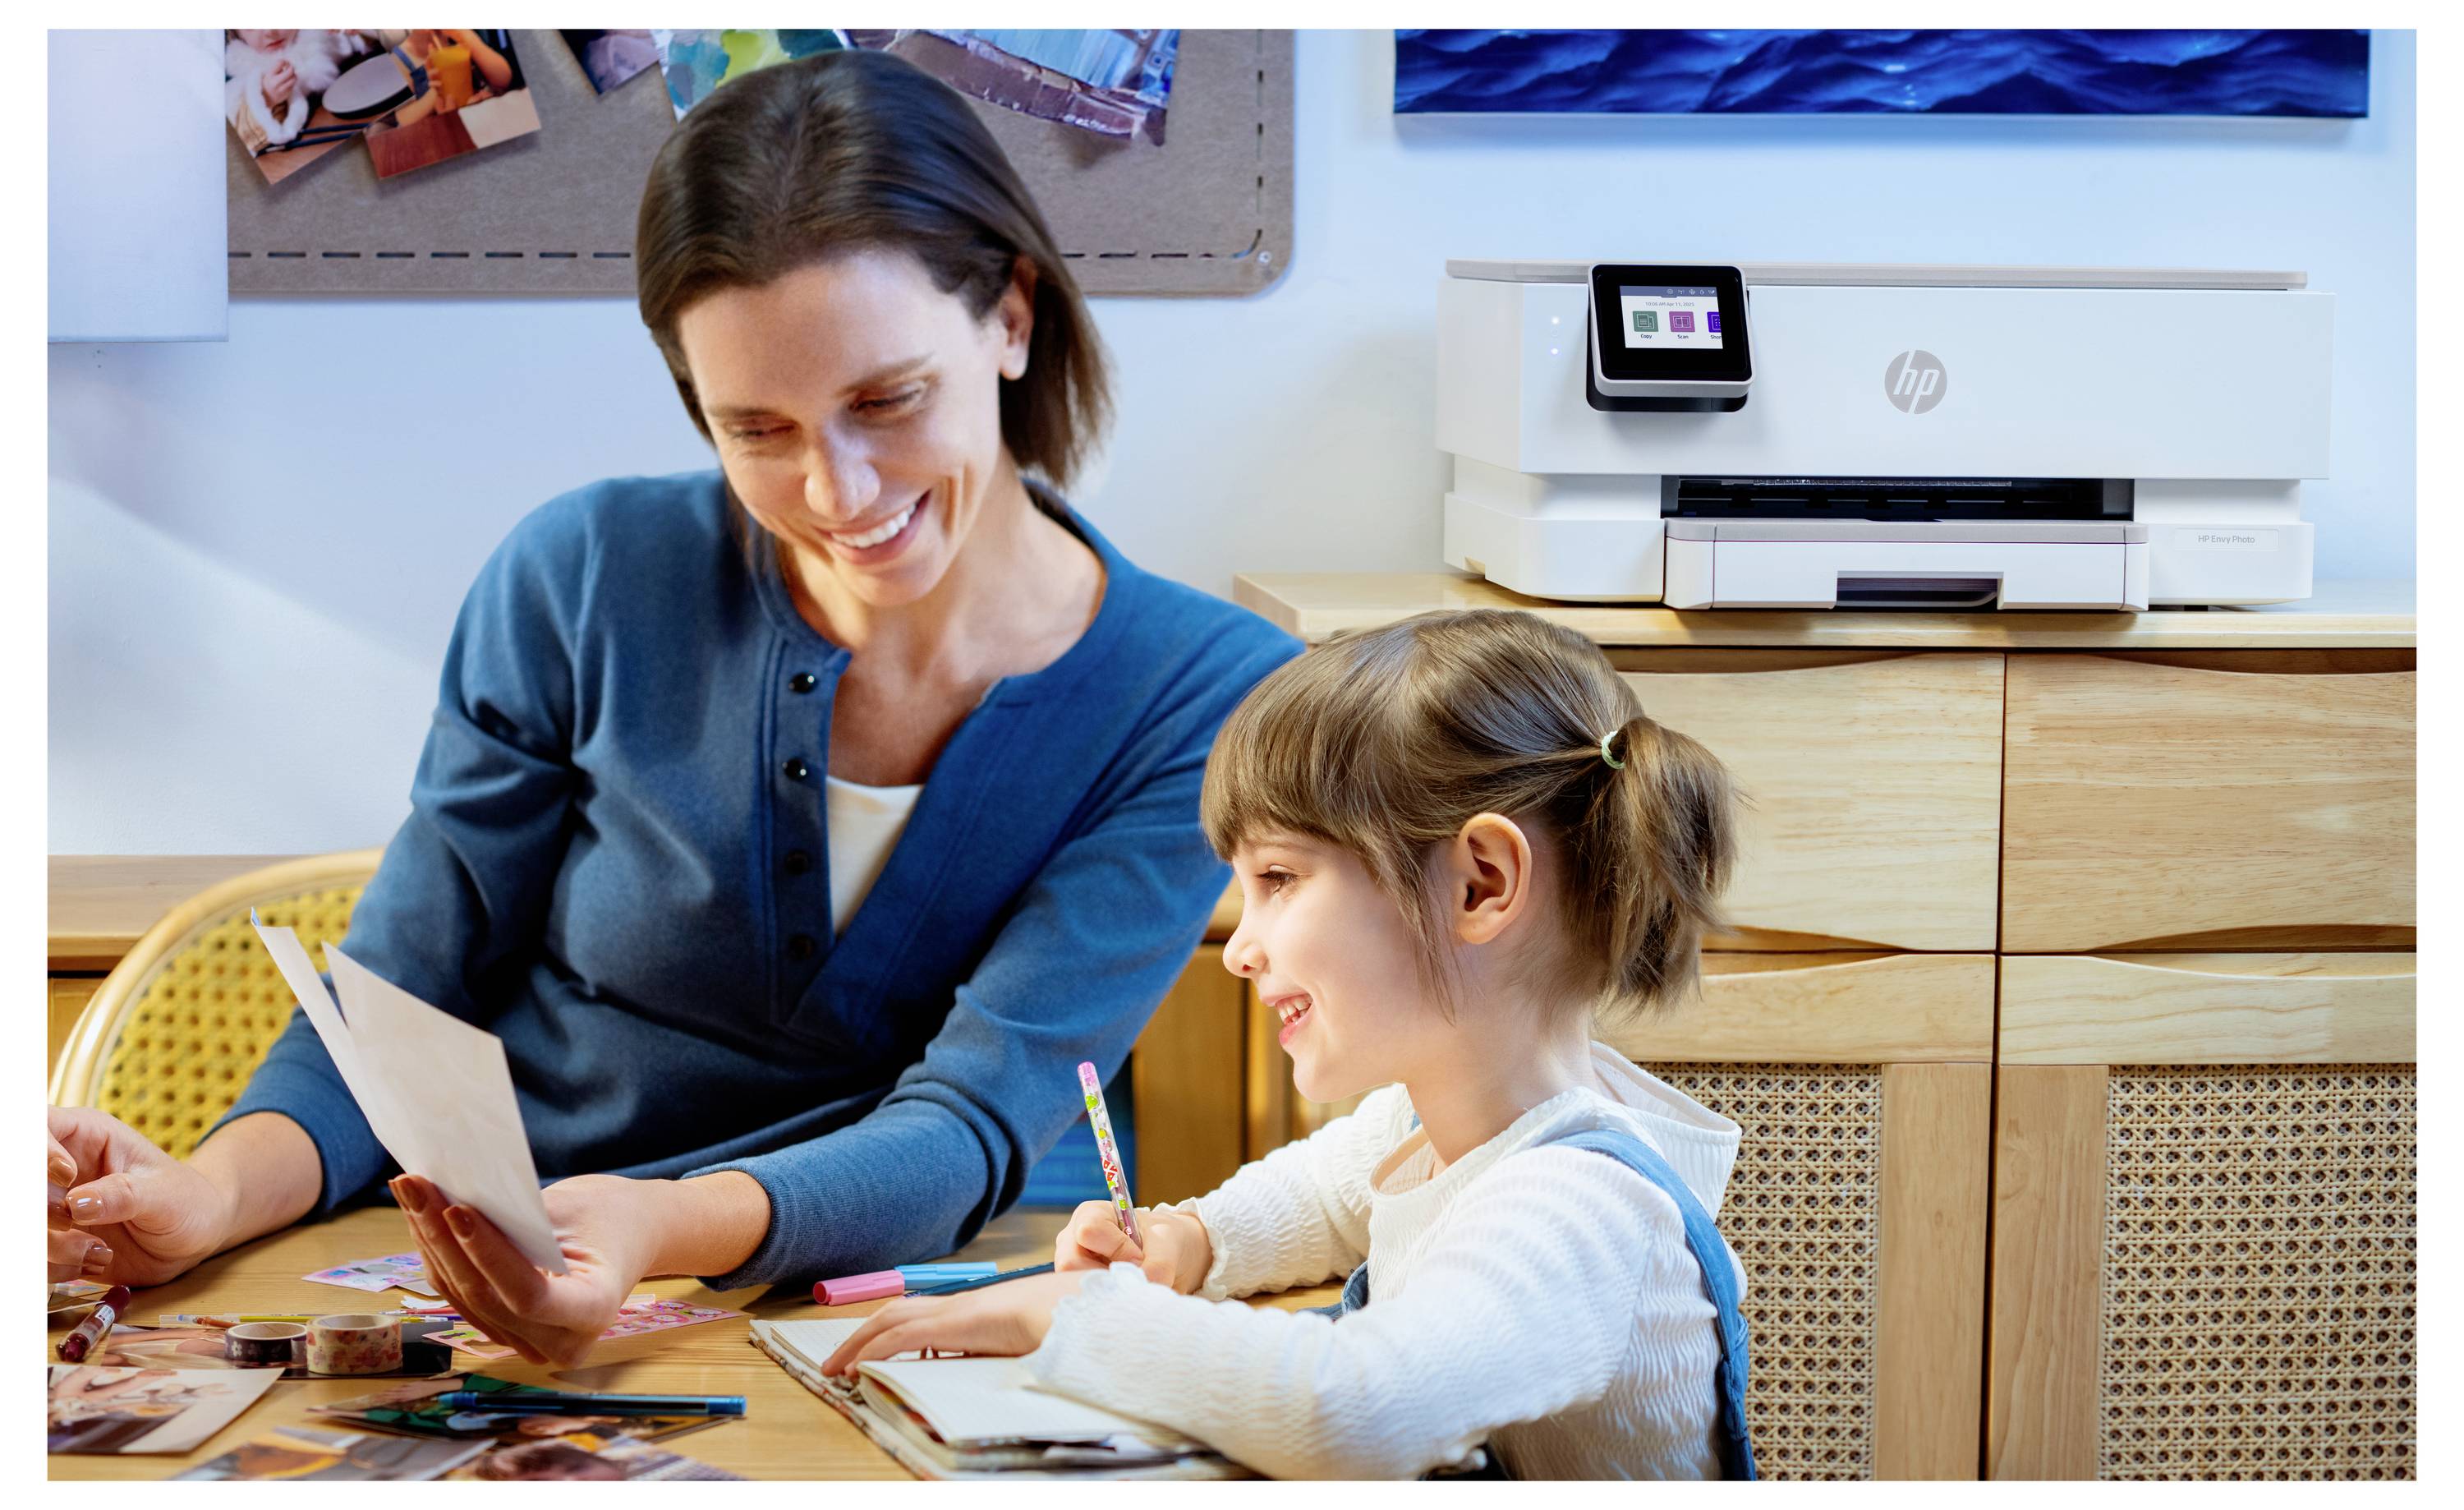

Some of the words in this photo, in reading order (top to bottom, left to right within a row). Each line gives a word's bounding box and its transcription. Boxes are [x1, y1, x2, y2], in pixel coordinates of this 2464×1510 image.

[1891, 349, 1941, 414] hp
[2198, 535, 2209, 543] HP
[2211, 536, 2231, 544] Envy
